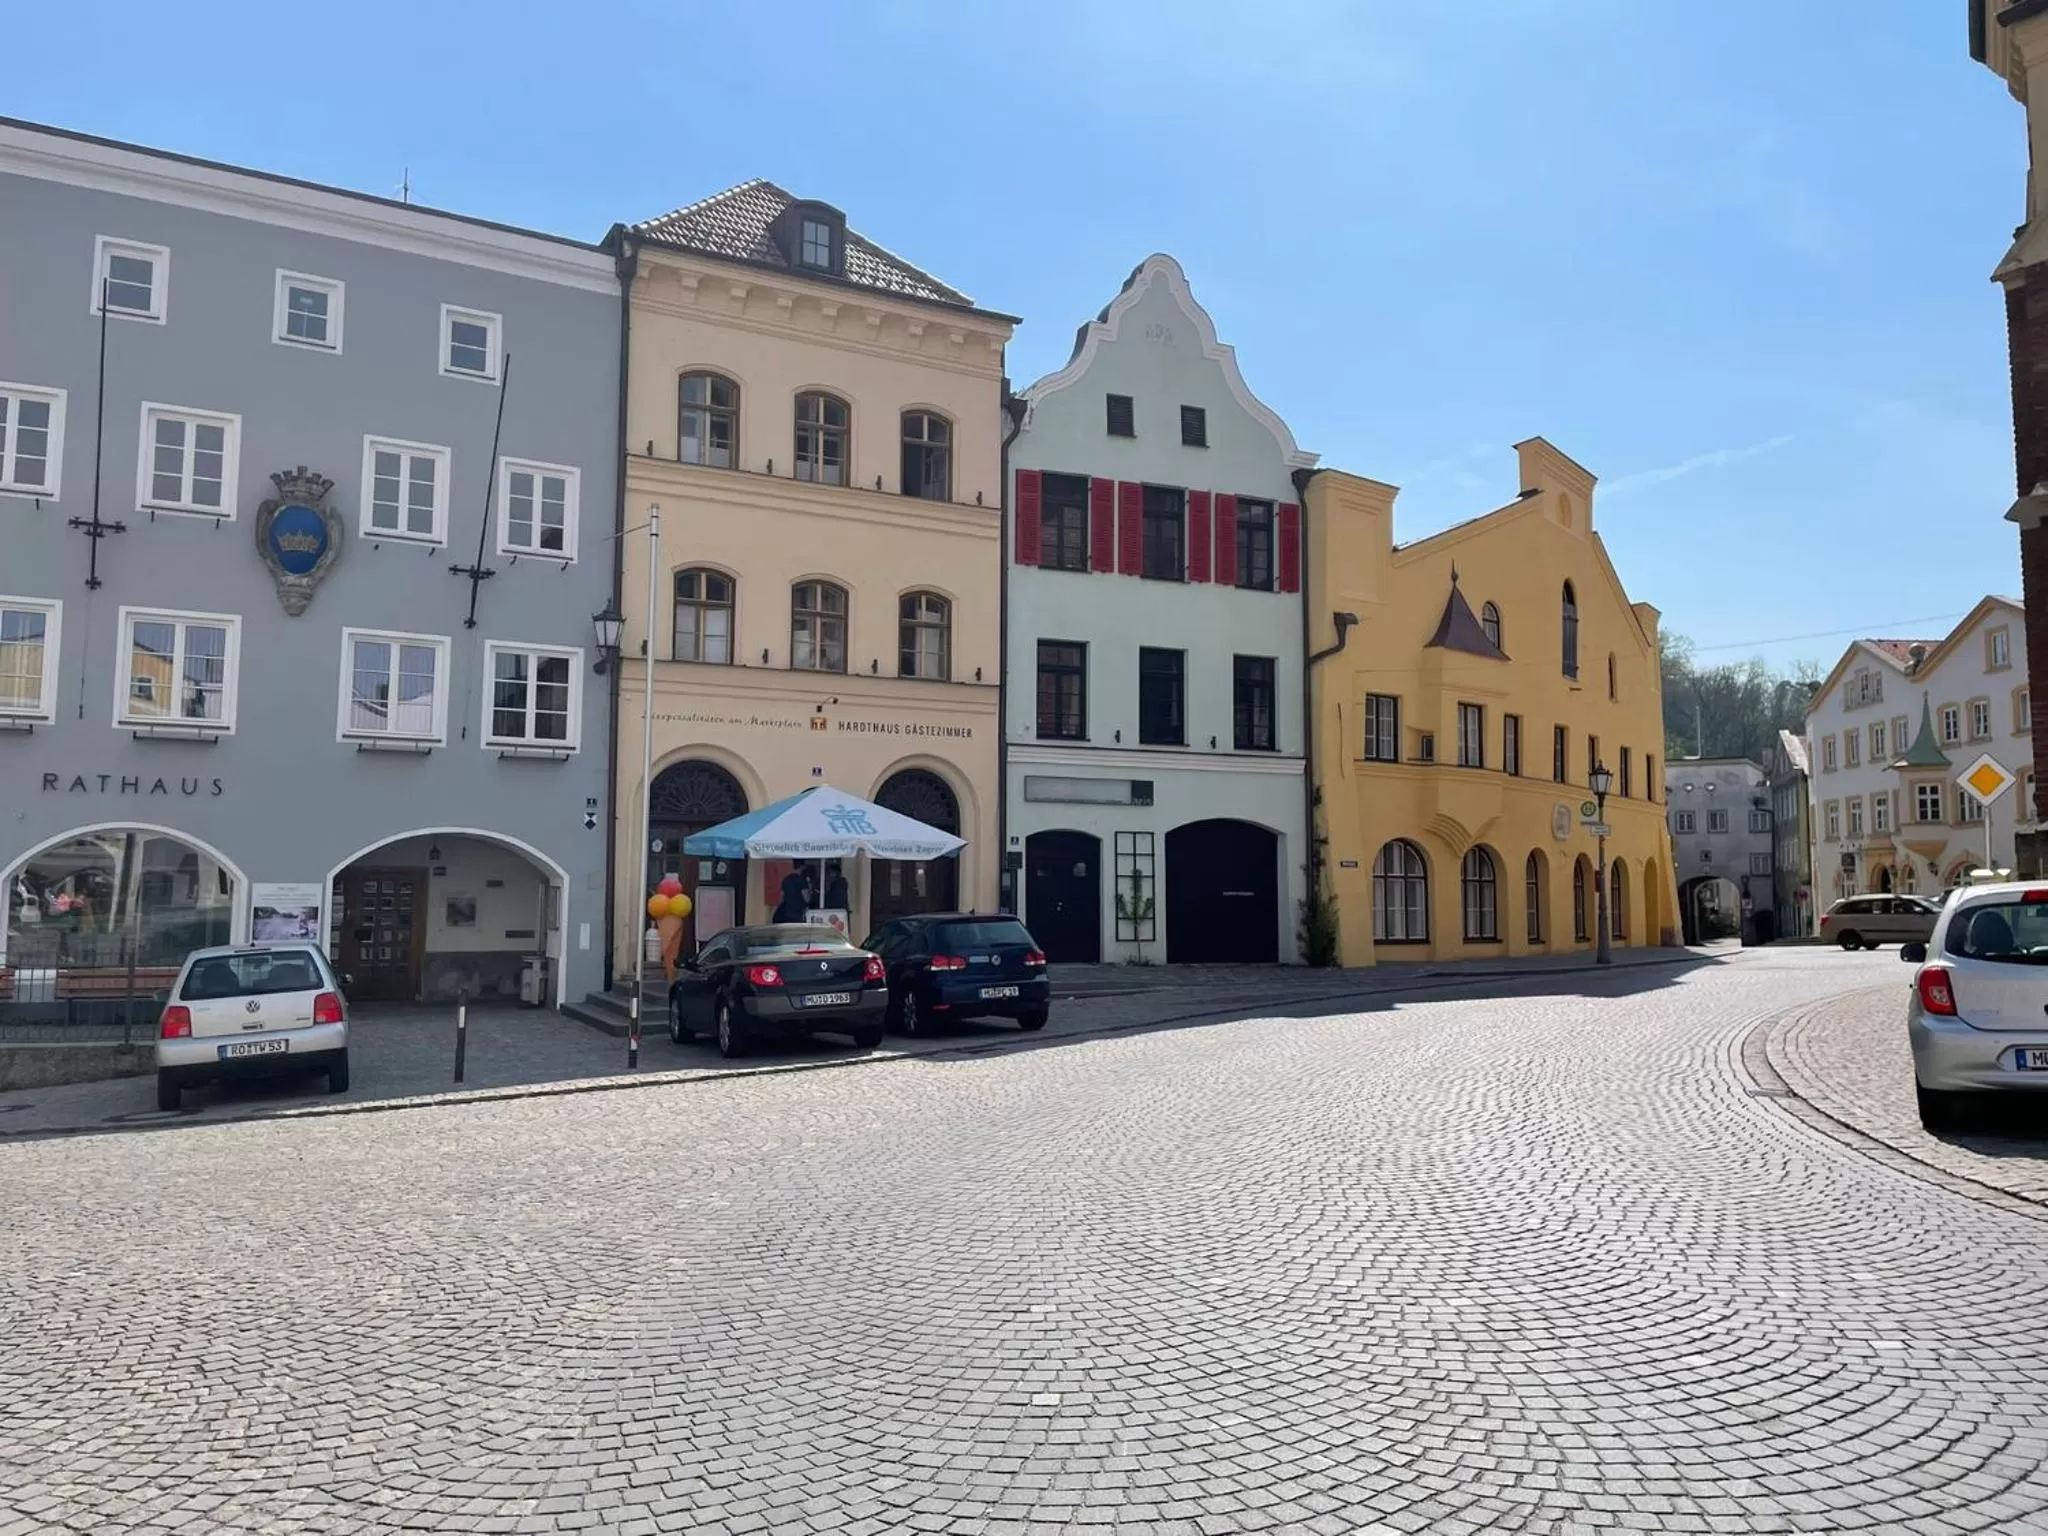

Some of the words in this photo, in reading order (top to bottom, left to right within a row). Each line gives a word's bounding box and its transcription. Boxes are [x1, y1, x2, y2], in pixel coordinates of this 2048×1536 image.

[838, 720, 900, 735] HARDTHAUS
[905, 724, 973, 738] GÄSTEZIMMER
[43, 773, 223, 796] RATHAUS
